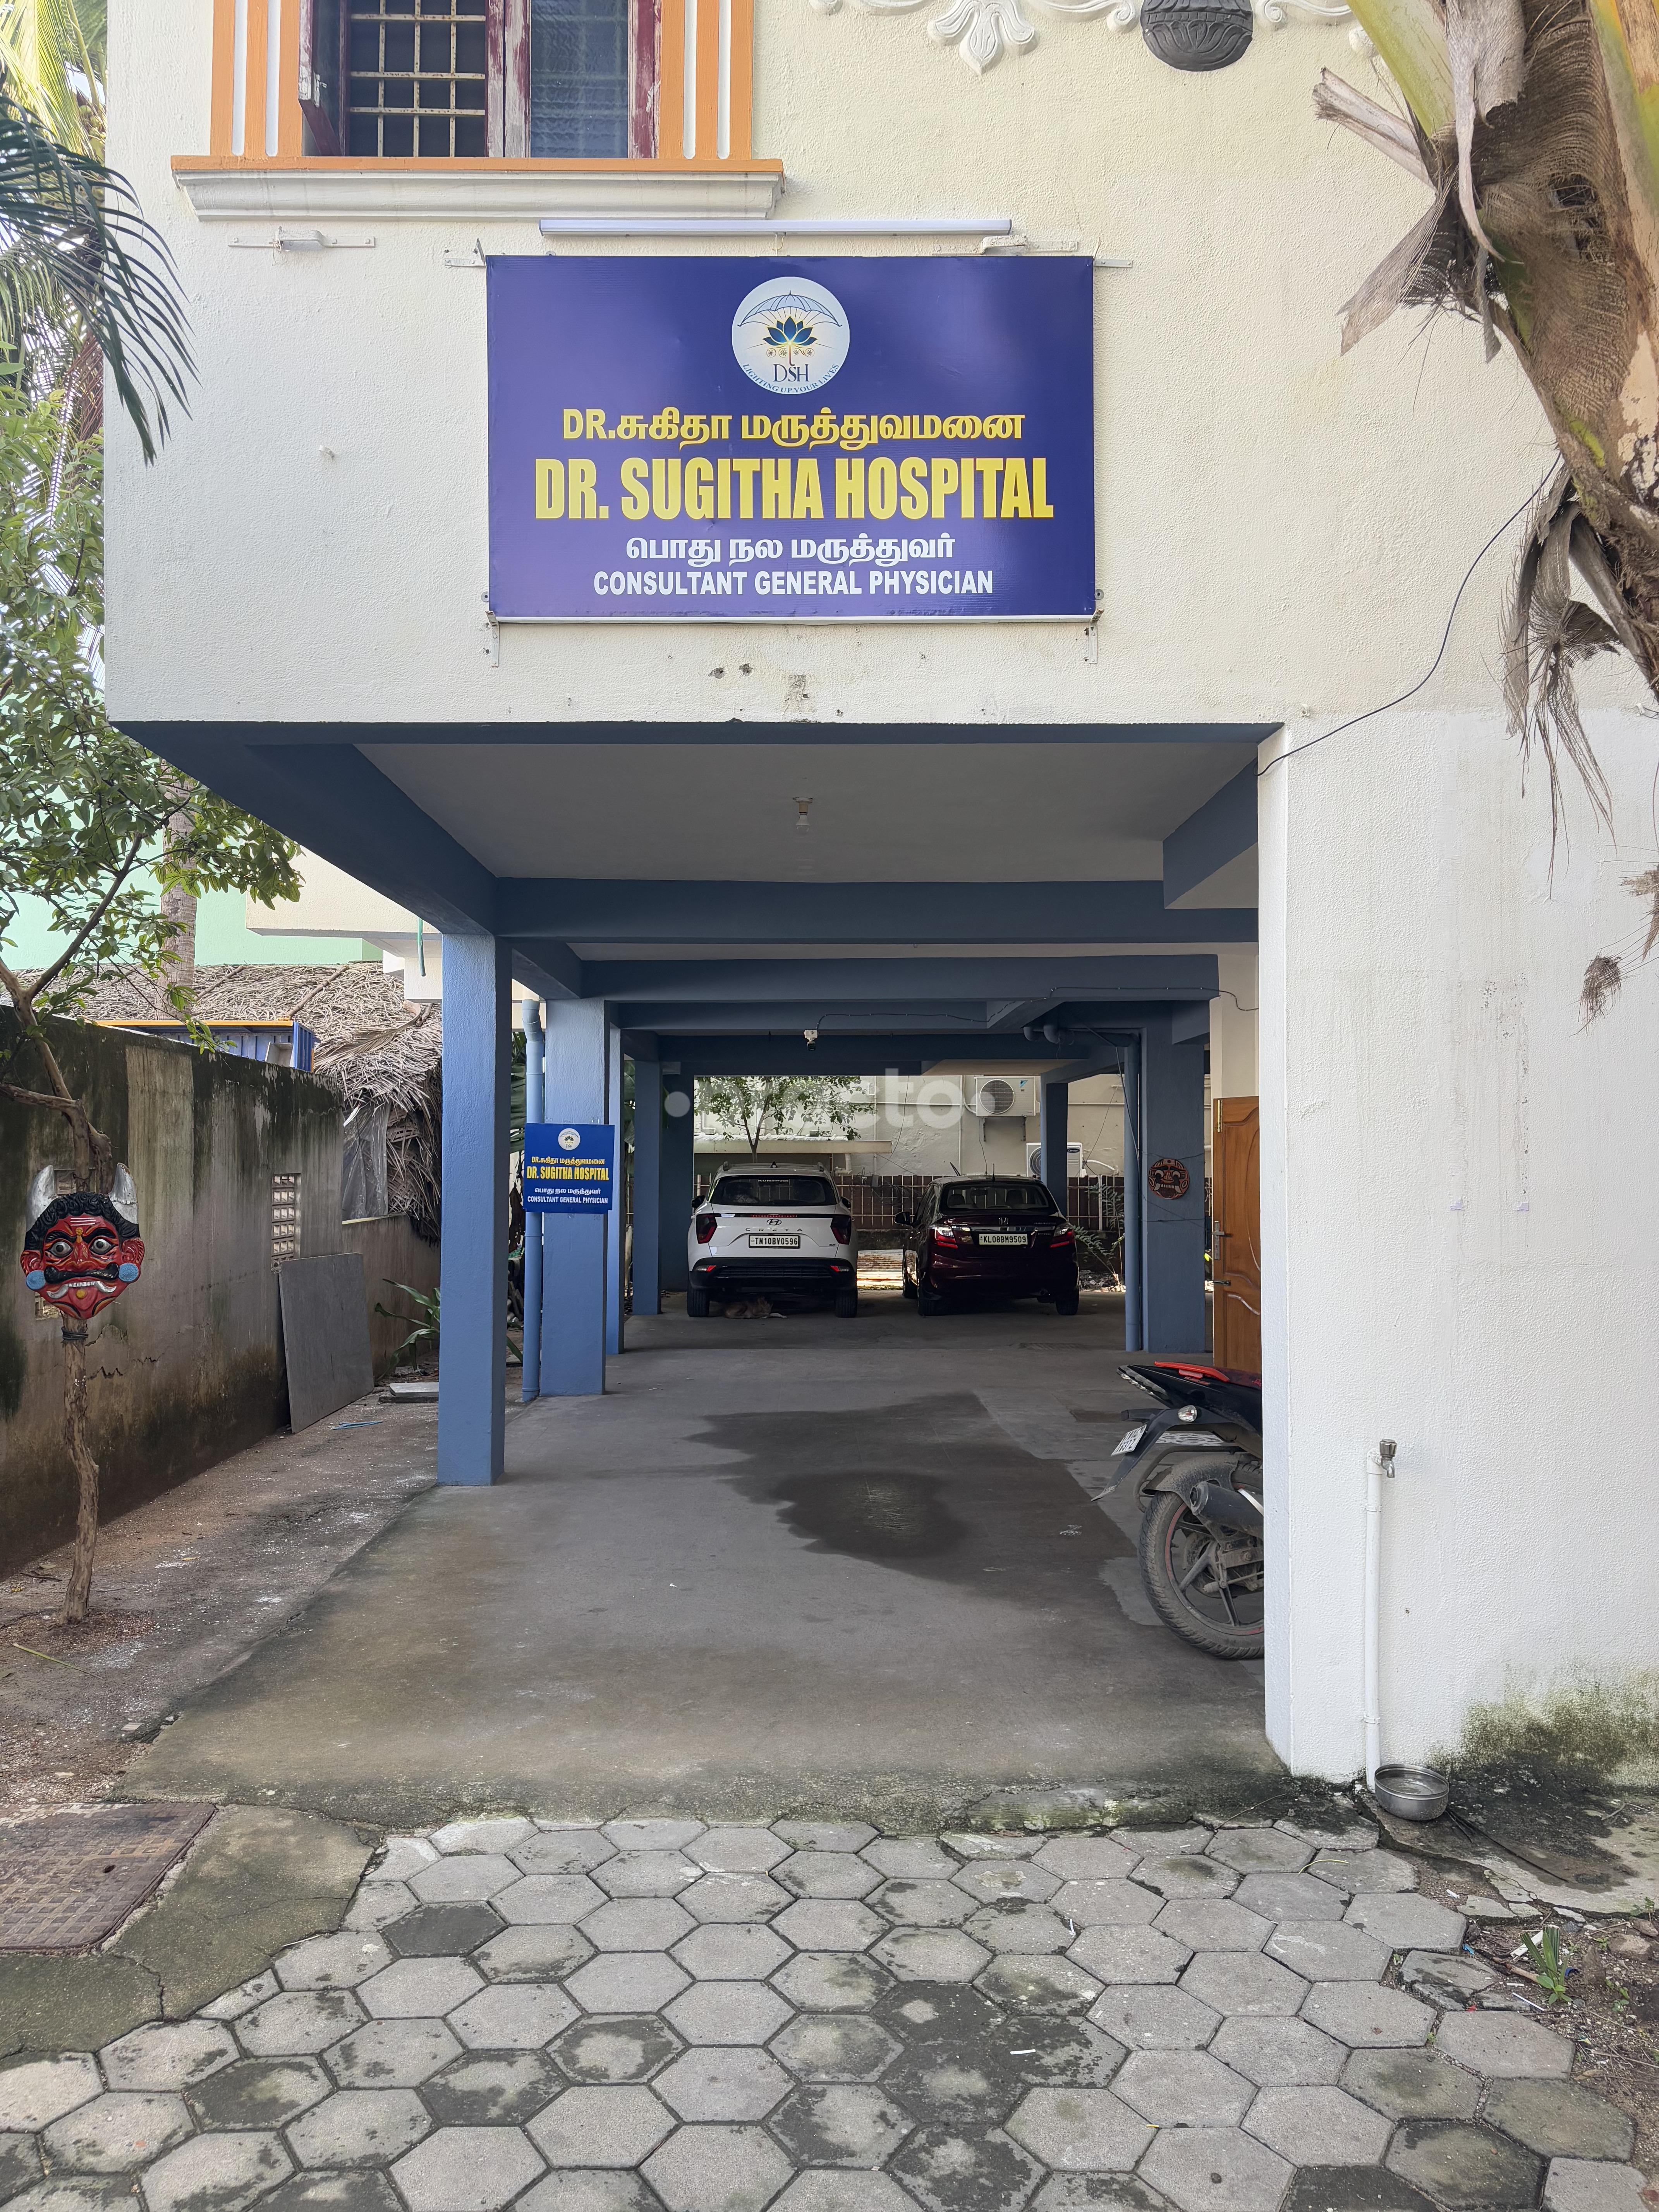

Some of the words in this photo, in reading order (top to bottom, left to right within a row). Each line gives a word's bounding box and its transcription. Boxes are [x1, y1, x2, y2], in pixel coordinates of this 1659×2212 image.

[743, 364, 778, 392] LIGHTING
[793, 382, 819, 393] YOUR
[818, 364, 839, 384] LIVES
[773, 364, 809, 382] DSH
[741, 407, 1025, 450] மருத்துவமனை
[535, 458, 609, 519] DR.
[620, 457, 824, 520] SUGITHA
[835, 457, 1054, 519] HOSPITAL
[626, 537, 721, 567] பொது
[729, 539, 783, 567] நல
[791, 532, 955, 567] மருத்துவர்
[594, 571, 747, 595] CONSULTANT
[754, 570, 862, 595] GENERAL
[869, 570, 993, 594] PHYSICIAN
[527, 1166, 539, 1179] DR.
[540, 1166, 573, 1180] SUGITHA
[574, 1167, 609, 1180] HOSPITAL
[560, 1157, 605, 1166] மருத்துவமனை
